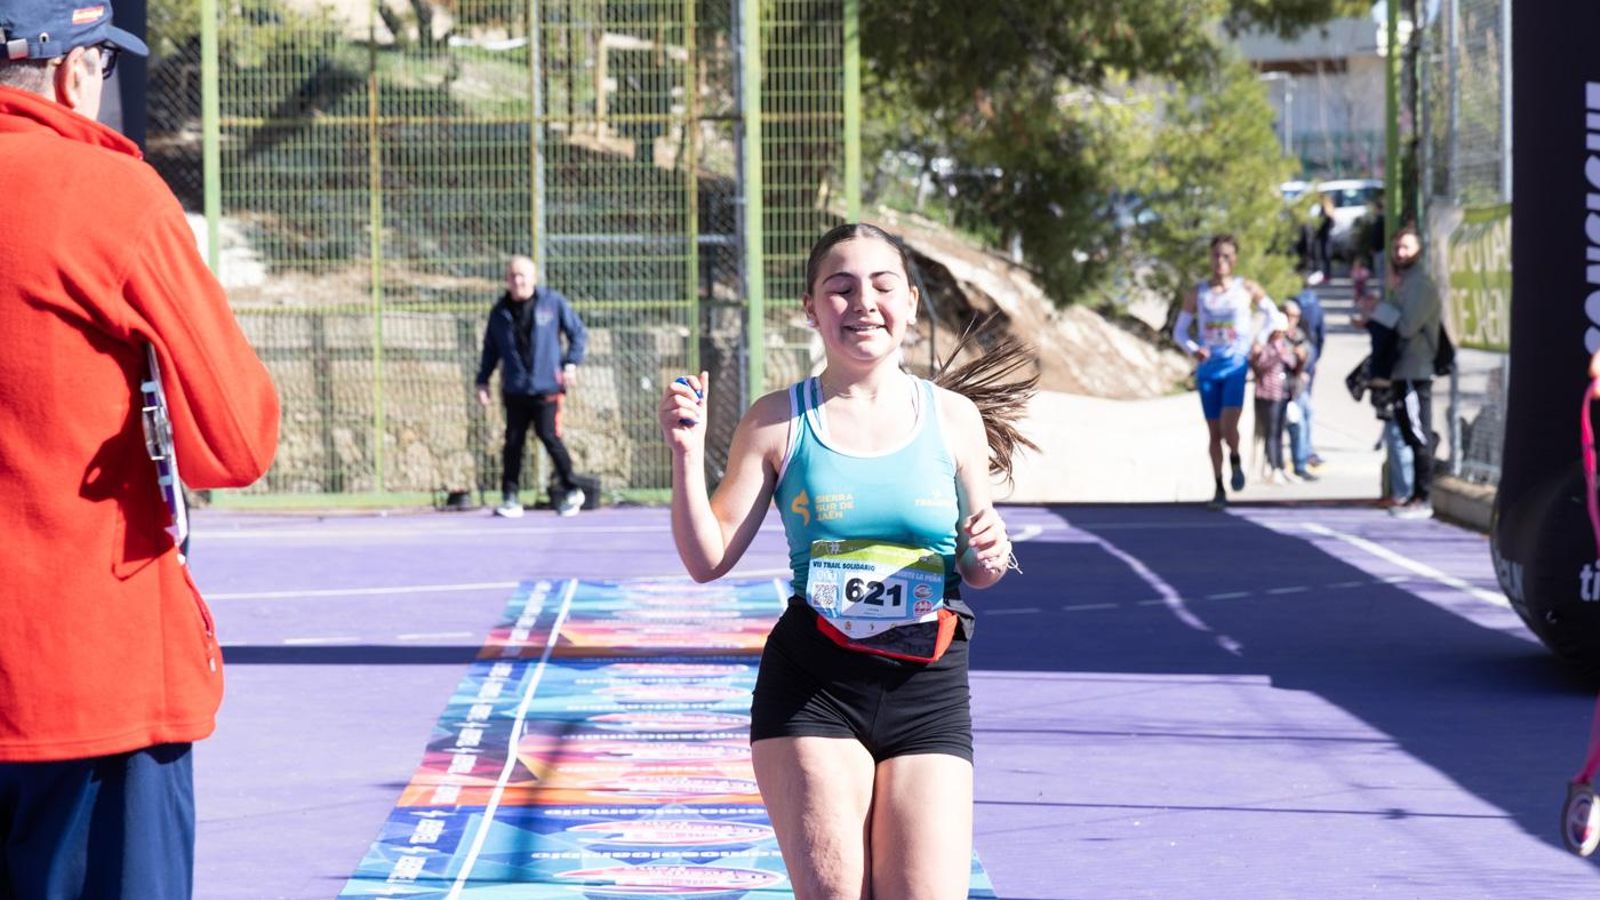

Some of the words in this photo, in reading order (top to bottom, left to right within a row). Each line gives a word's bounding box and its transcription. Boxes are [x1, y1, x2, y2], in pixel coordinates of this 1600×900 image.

[816, 494, 855, 503] SIERRA
[816, 503, 836, 511] SUR
[840, 502, 855, 511] DE
[842, 563, 875, 572] SOLIDARIO
[846, 578, 902, 607] 621
